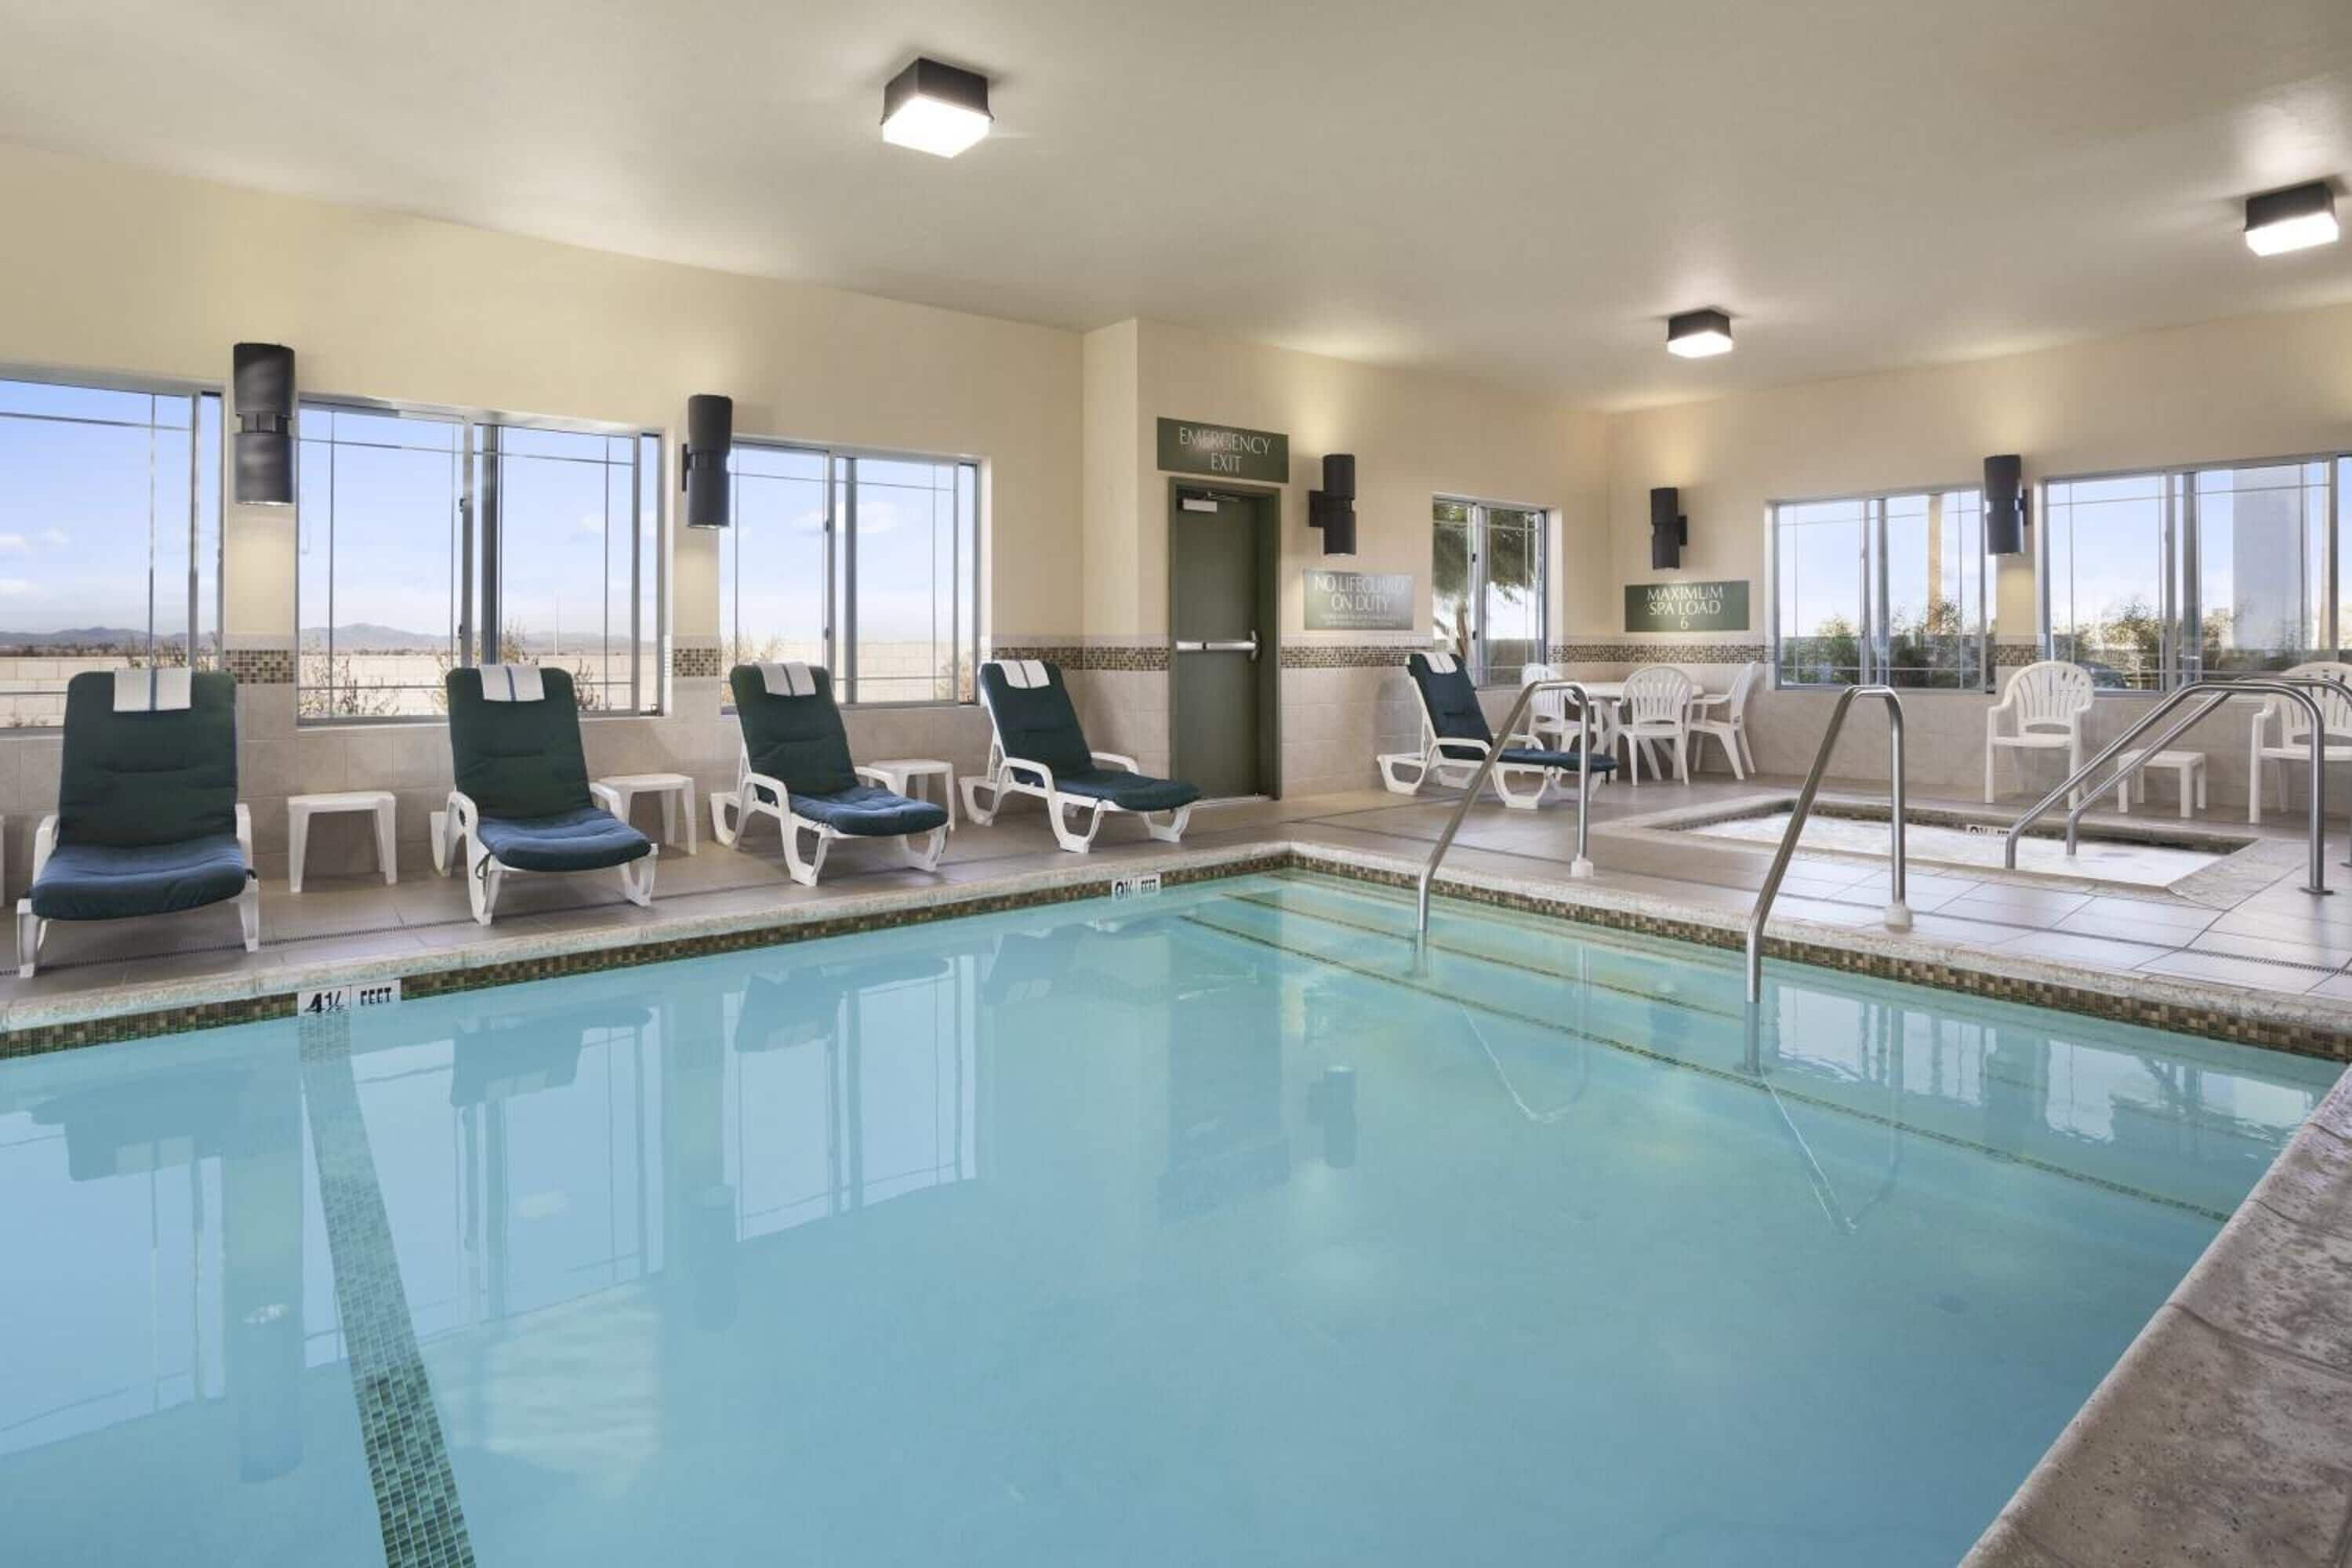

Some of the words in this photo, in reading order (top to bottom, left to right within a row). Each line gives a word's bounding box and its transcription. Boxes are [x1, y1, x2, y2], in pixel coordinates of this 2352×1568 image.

[1179, 426, 1271, 455] EMERGENCY
[1210, 452, 1242, 474] EXIT
[1315, 576, 1336, 591] NO
[1647, 586, 1724, 601] MAXIMUM
[1330, 593, 1353, 610] ON
[1355, 594, 1389, 613] DUTY
[1649, 601, 1675, 615] SPA
[1679, 601, 1721, 615] LOAD
[1680, 615, 1690, 630] 6
[360, 986, 392, 1007] FEET
